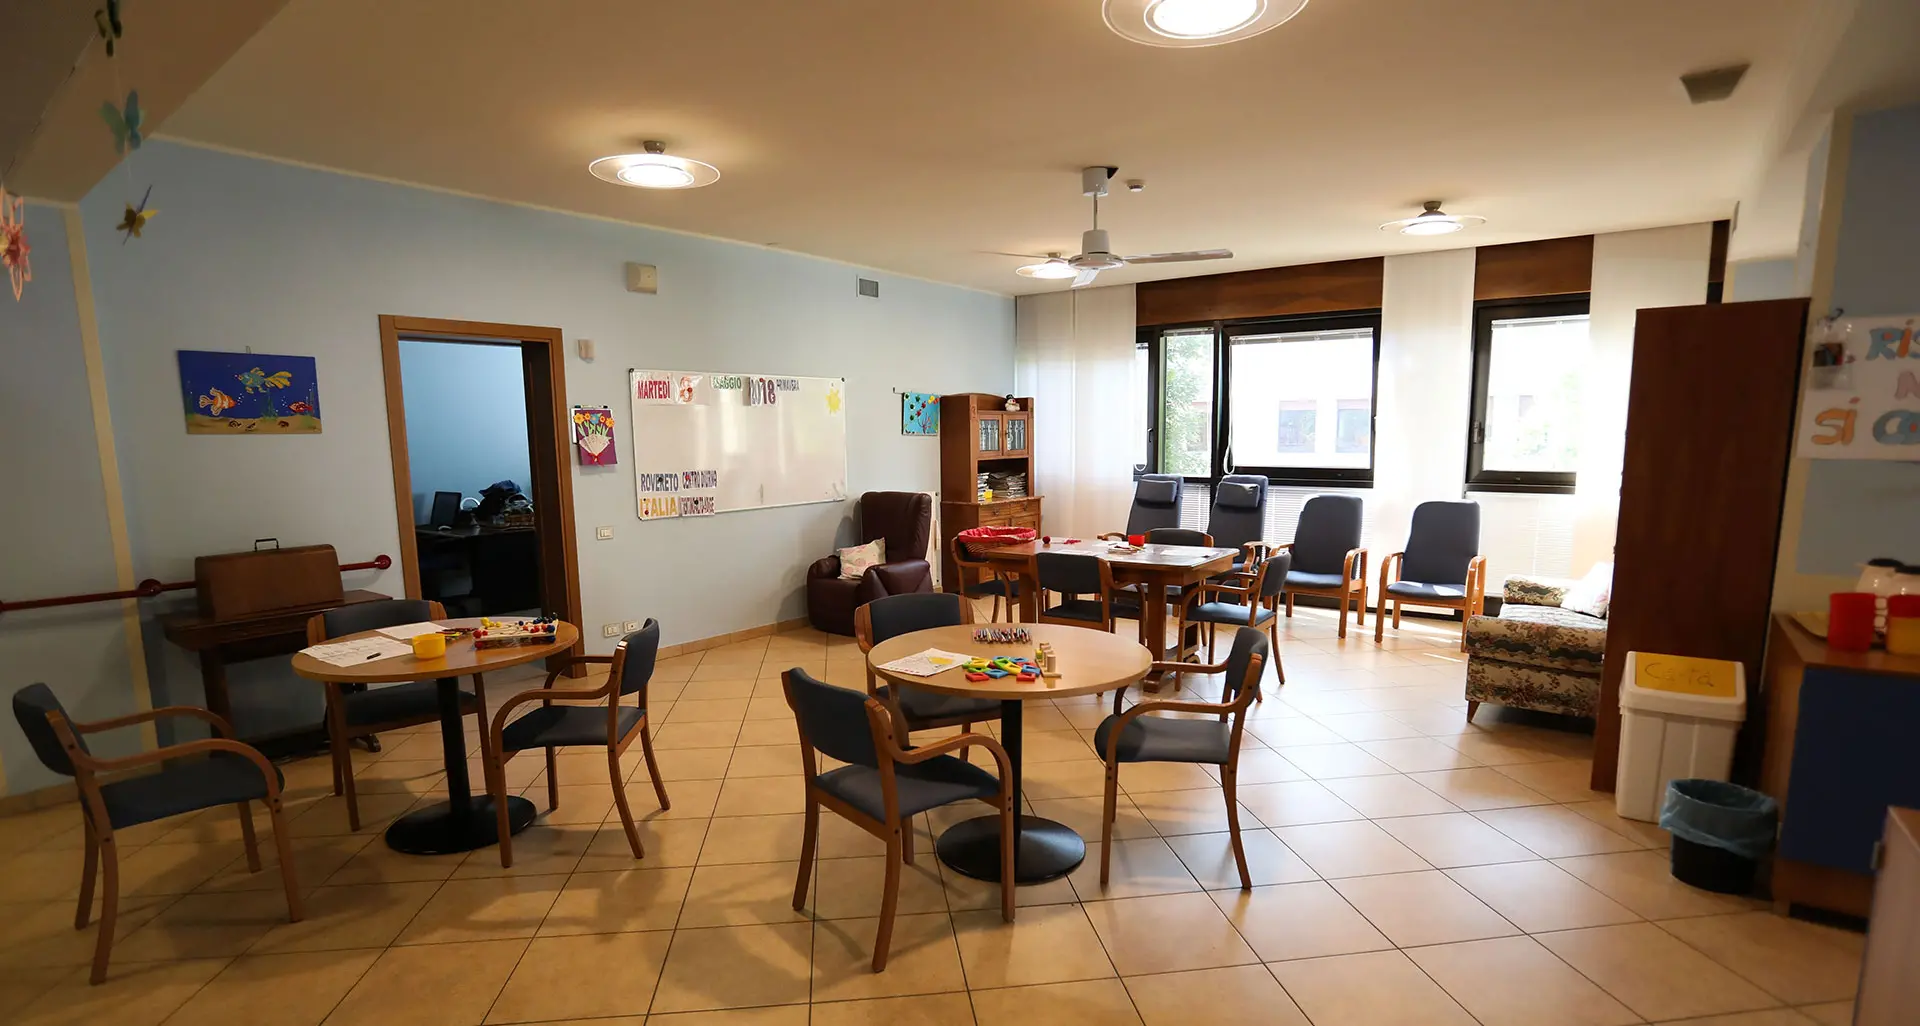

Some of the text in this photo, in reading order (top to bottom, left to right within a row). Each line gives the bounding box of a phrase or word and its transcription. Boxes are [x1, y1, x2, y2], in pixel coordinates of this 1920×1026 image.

[679, 377, 693, 403] 8
[641, 473, 679, 492] ROVERETO
[640, 497, 678, 518] ITALIA
